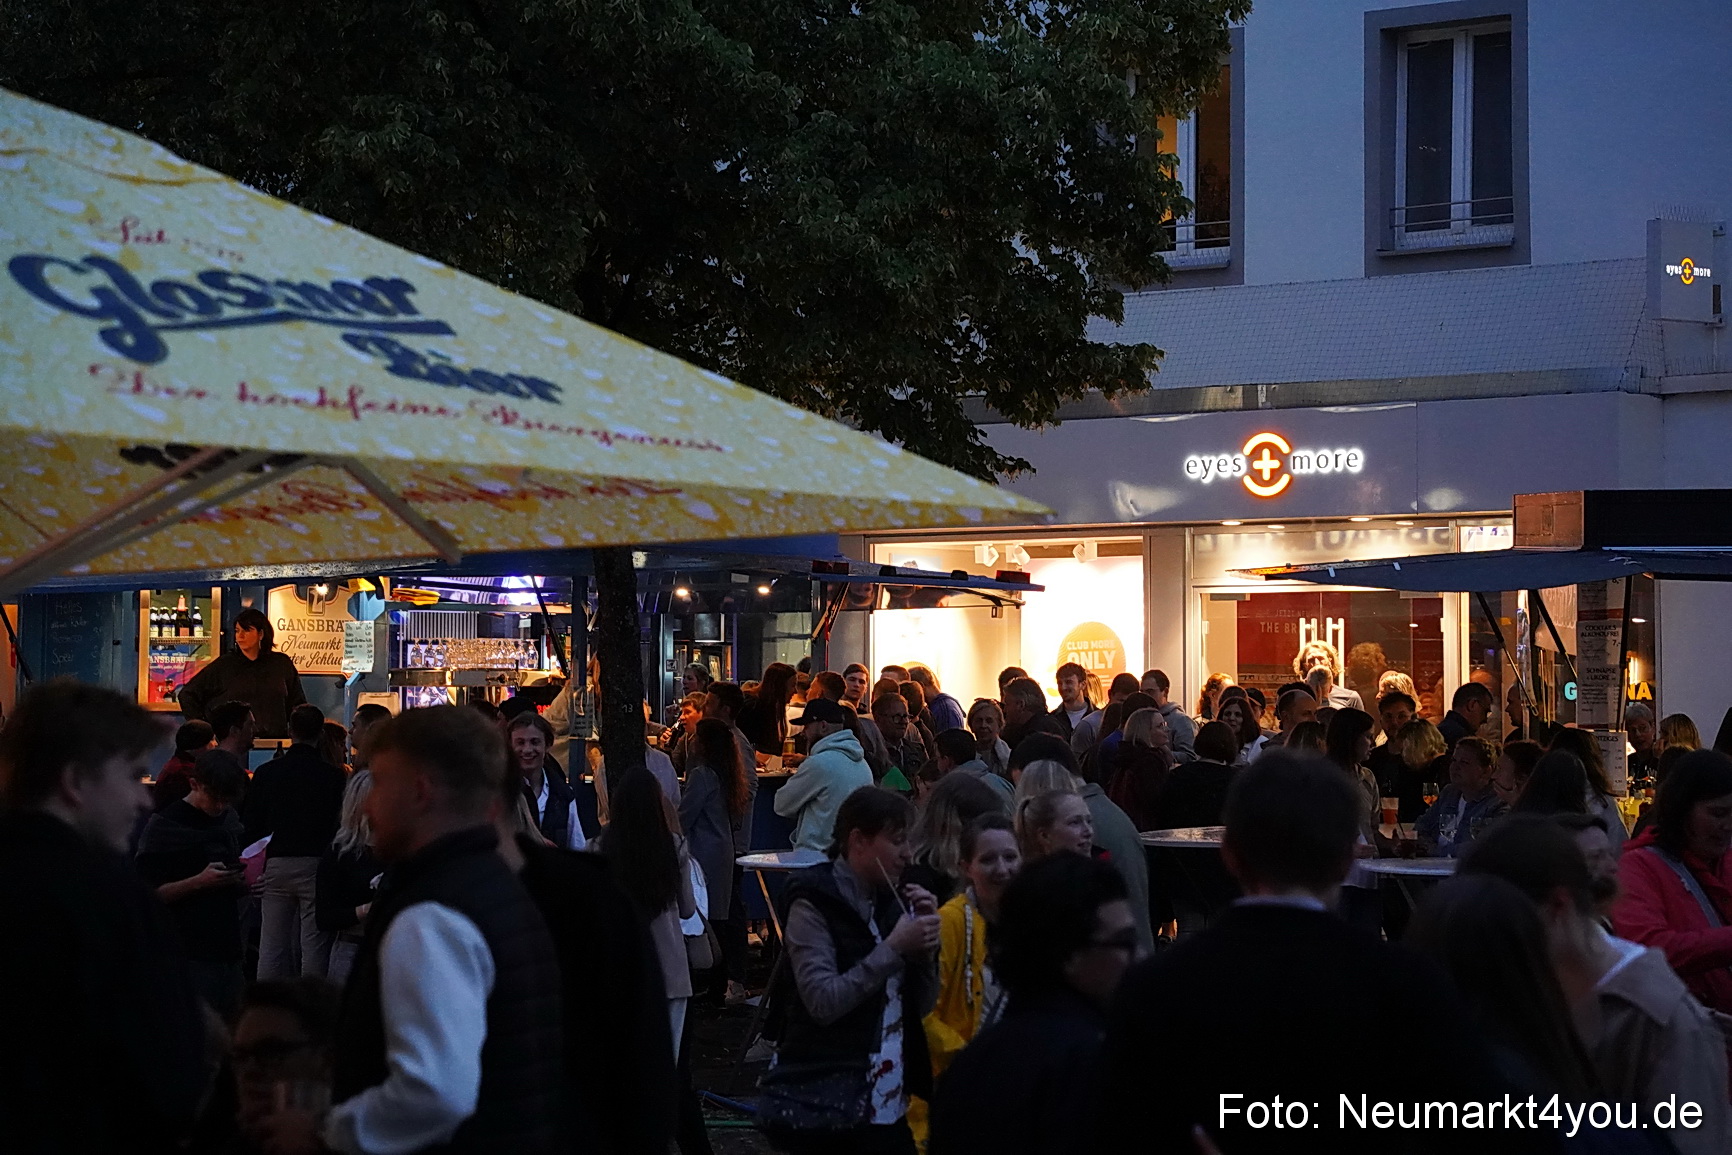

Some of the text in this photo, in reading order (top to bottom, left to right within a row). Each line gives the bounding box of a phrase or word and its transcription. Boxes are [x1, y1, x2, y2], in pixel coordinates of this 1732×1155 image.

[1666, 265, 1682, 276] eyes
[1693, 267, 1711, 278] more
[1186, 456, 1242, 480] eyes
[1292, 451, 1358, 470] more
[277, 618, 345, 632] GANSBRÄ
[1260, 622, 1279, 633] THE
[281, 634, 341, 652] Neumarkt
[1067, 640, 1115, 650] CLUB MORE
[305, 651, 343, 669] Schluc
[1067, 650, 1116, 669] ONLY
[622, 703, 634, 713] 13
